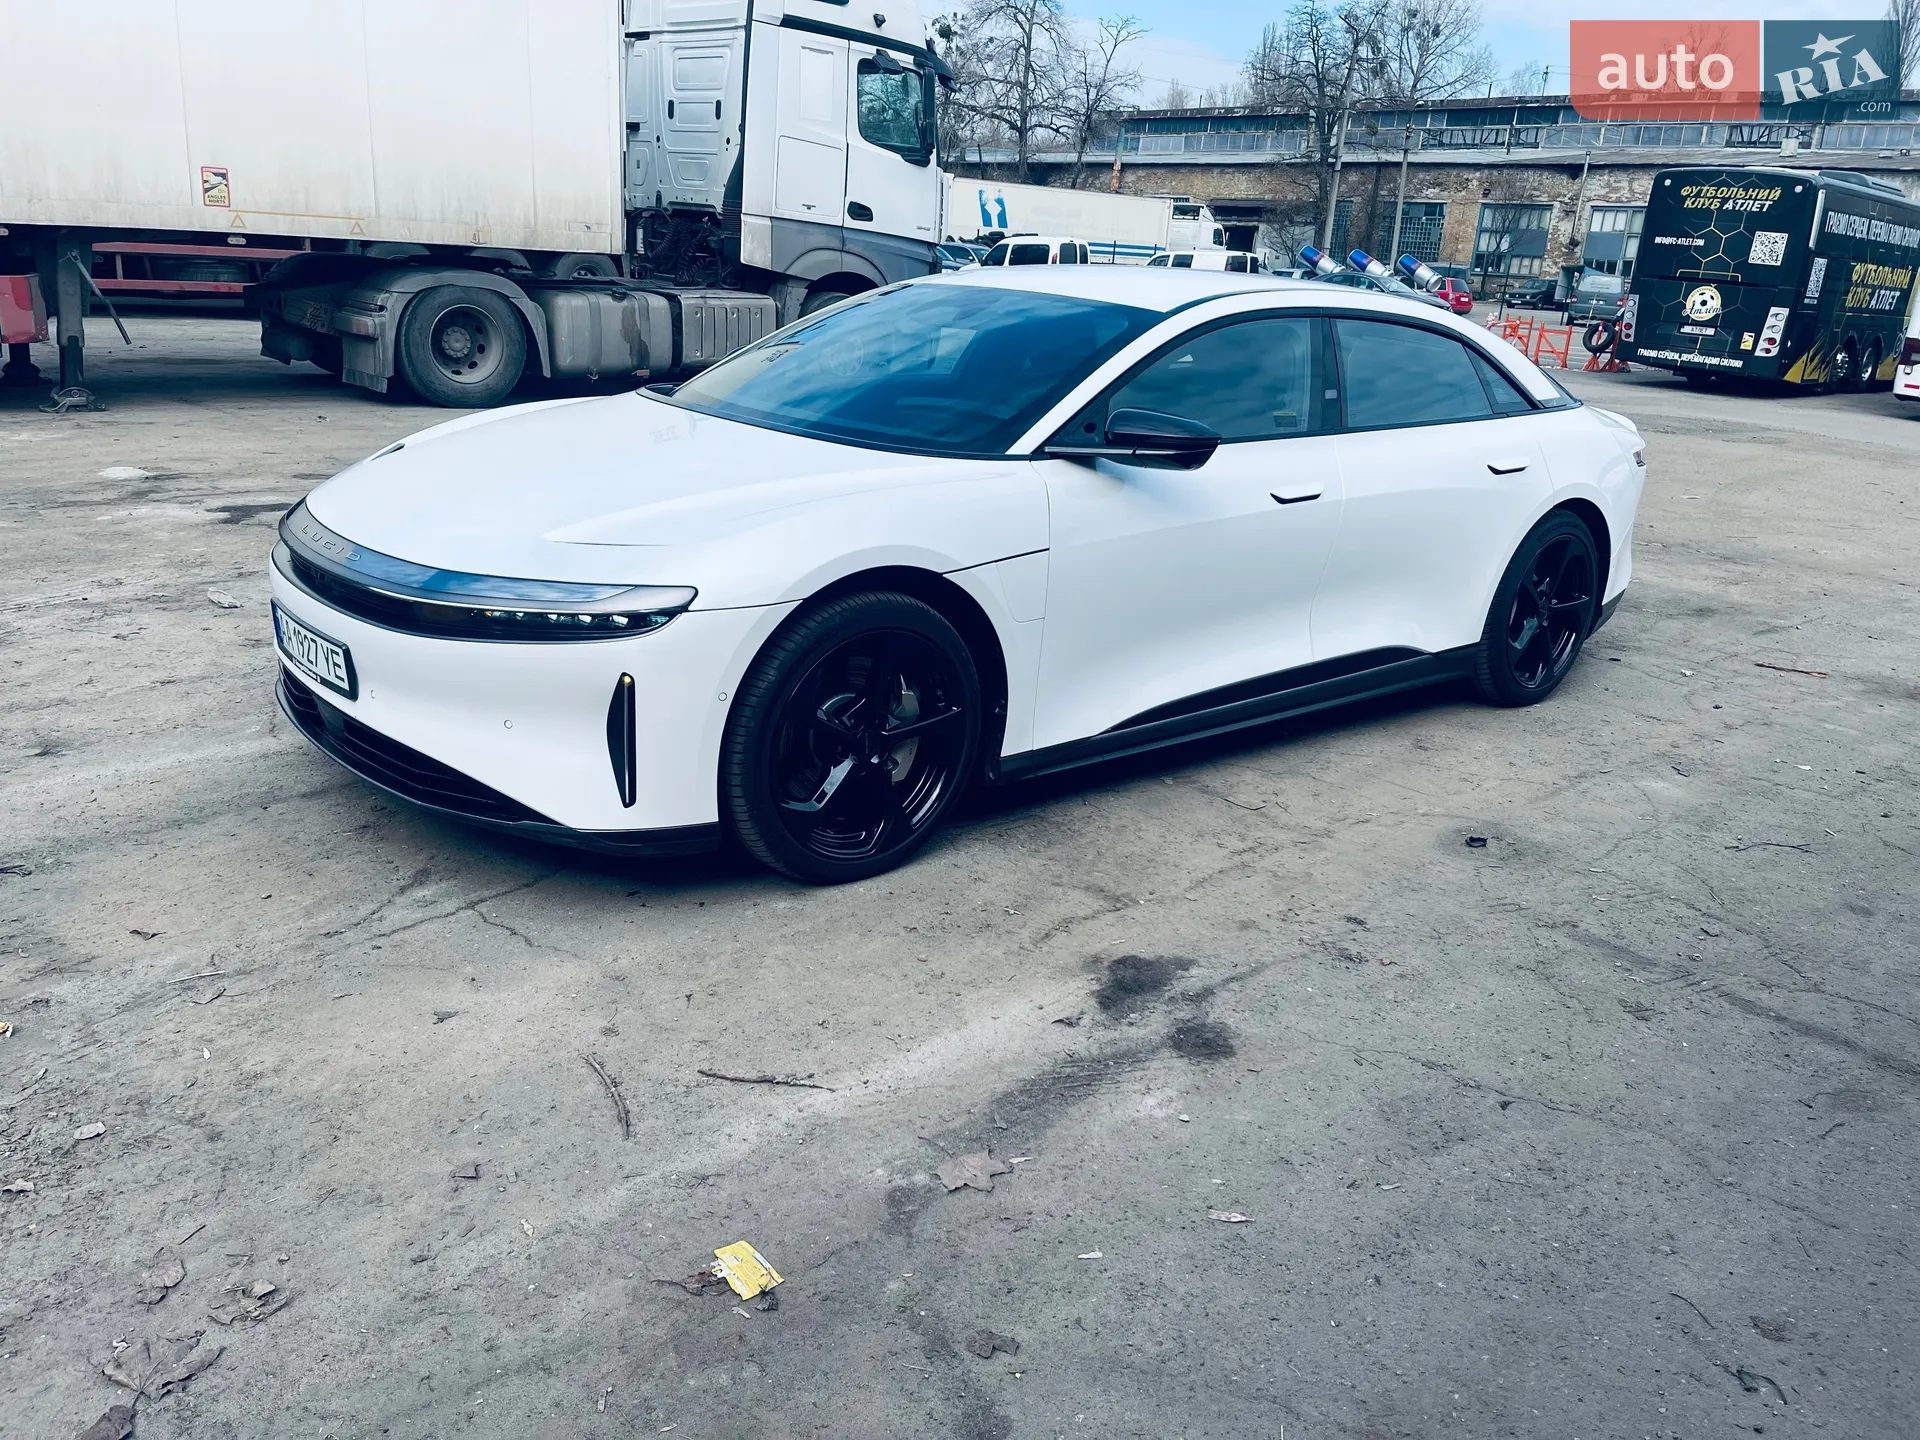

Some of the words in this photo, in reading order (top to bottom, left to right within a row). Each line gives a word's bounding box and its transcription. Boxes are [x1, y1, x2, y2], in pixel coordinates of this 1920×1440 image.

[1681, 186, 1781, 200] ФУТБОЛЬНИЙ
[1684, 198, 1721, 209] КЛУБ
[1722, 199, 1773, 212] АТЛЕТ
[1852, 263, 1912, 289] ФУТБОЛЬНИЙ
[1845, 287, 1872, 308] КЛУБ
[1869, 289, 1901, 310] АТЛЕТ
[301, 524, 362, 561] LUCID
[320, 643, 345, 683] YE
